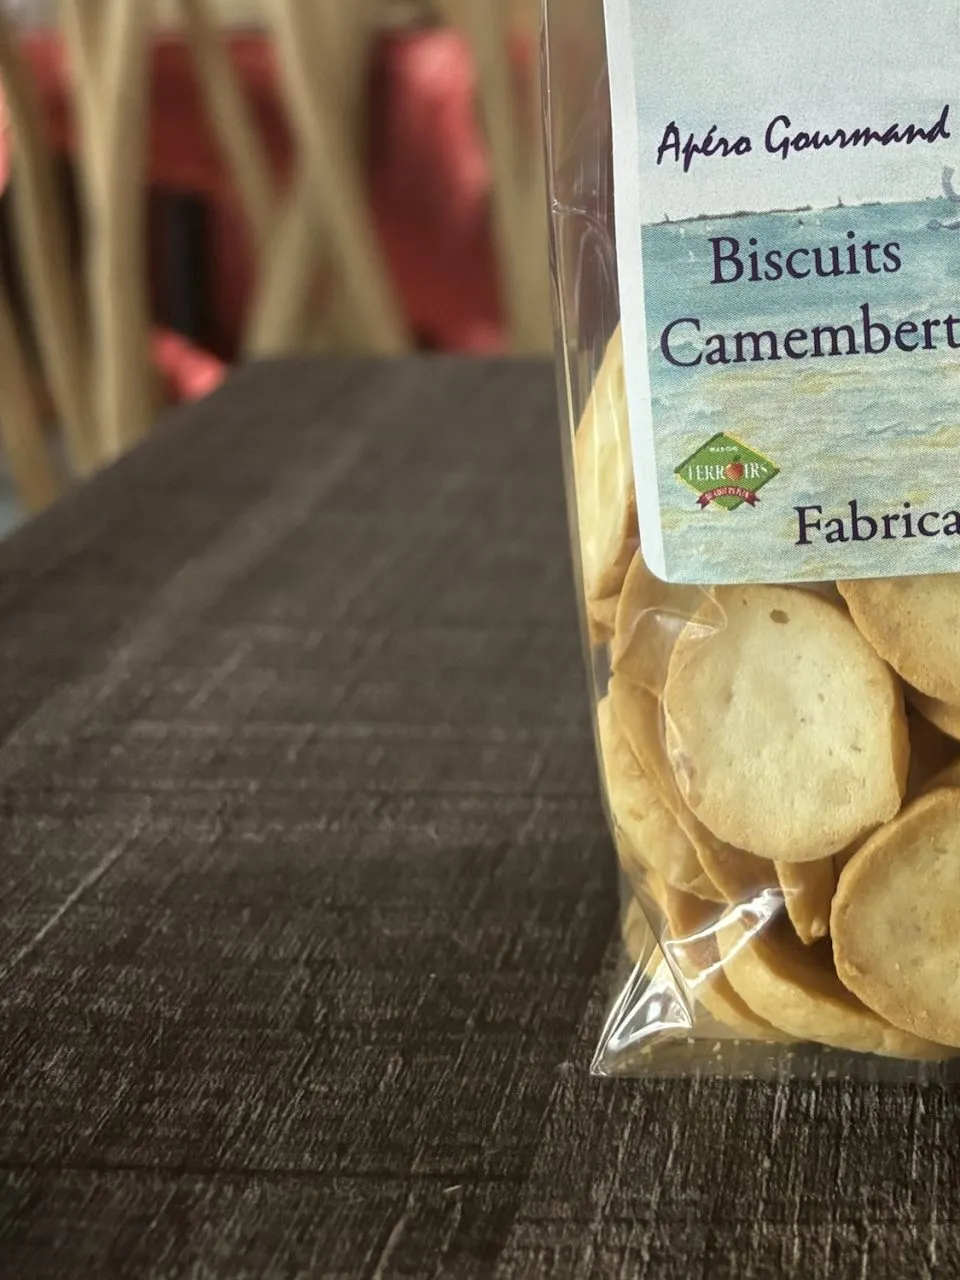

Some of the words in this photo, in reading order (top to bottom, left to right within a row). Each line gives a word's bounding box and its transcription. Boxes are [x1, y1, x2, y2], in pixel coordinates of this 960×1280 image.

[657, 121, 752, 172] Apéro
[765, 105, 950, 160] Gourmand
[709, 231, 902, 284] Biscuits
